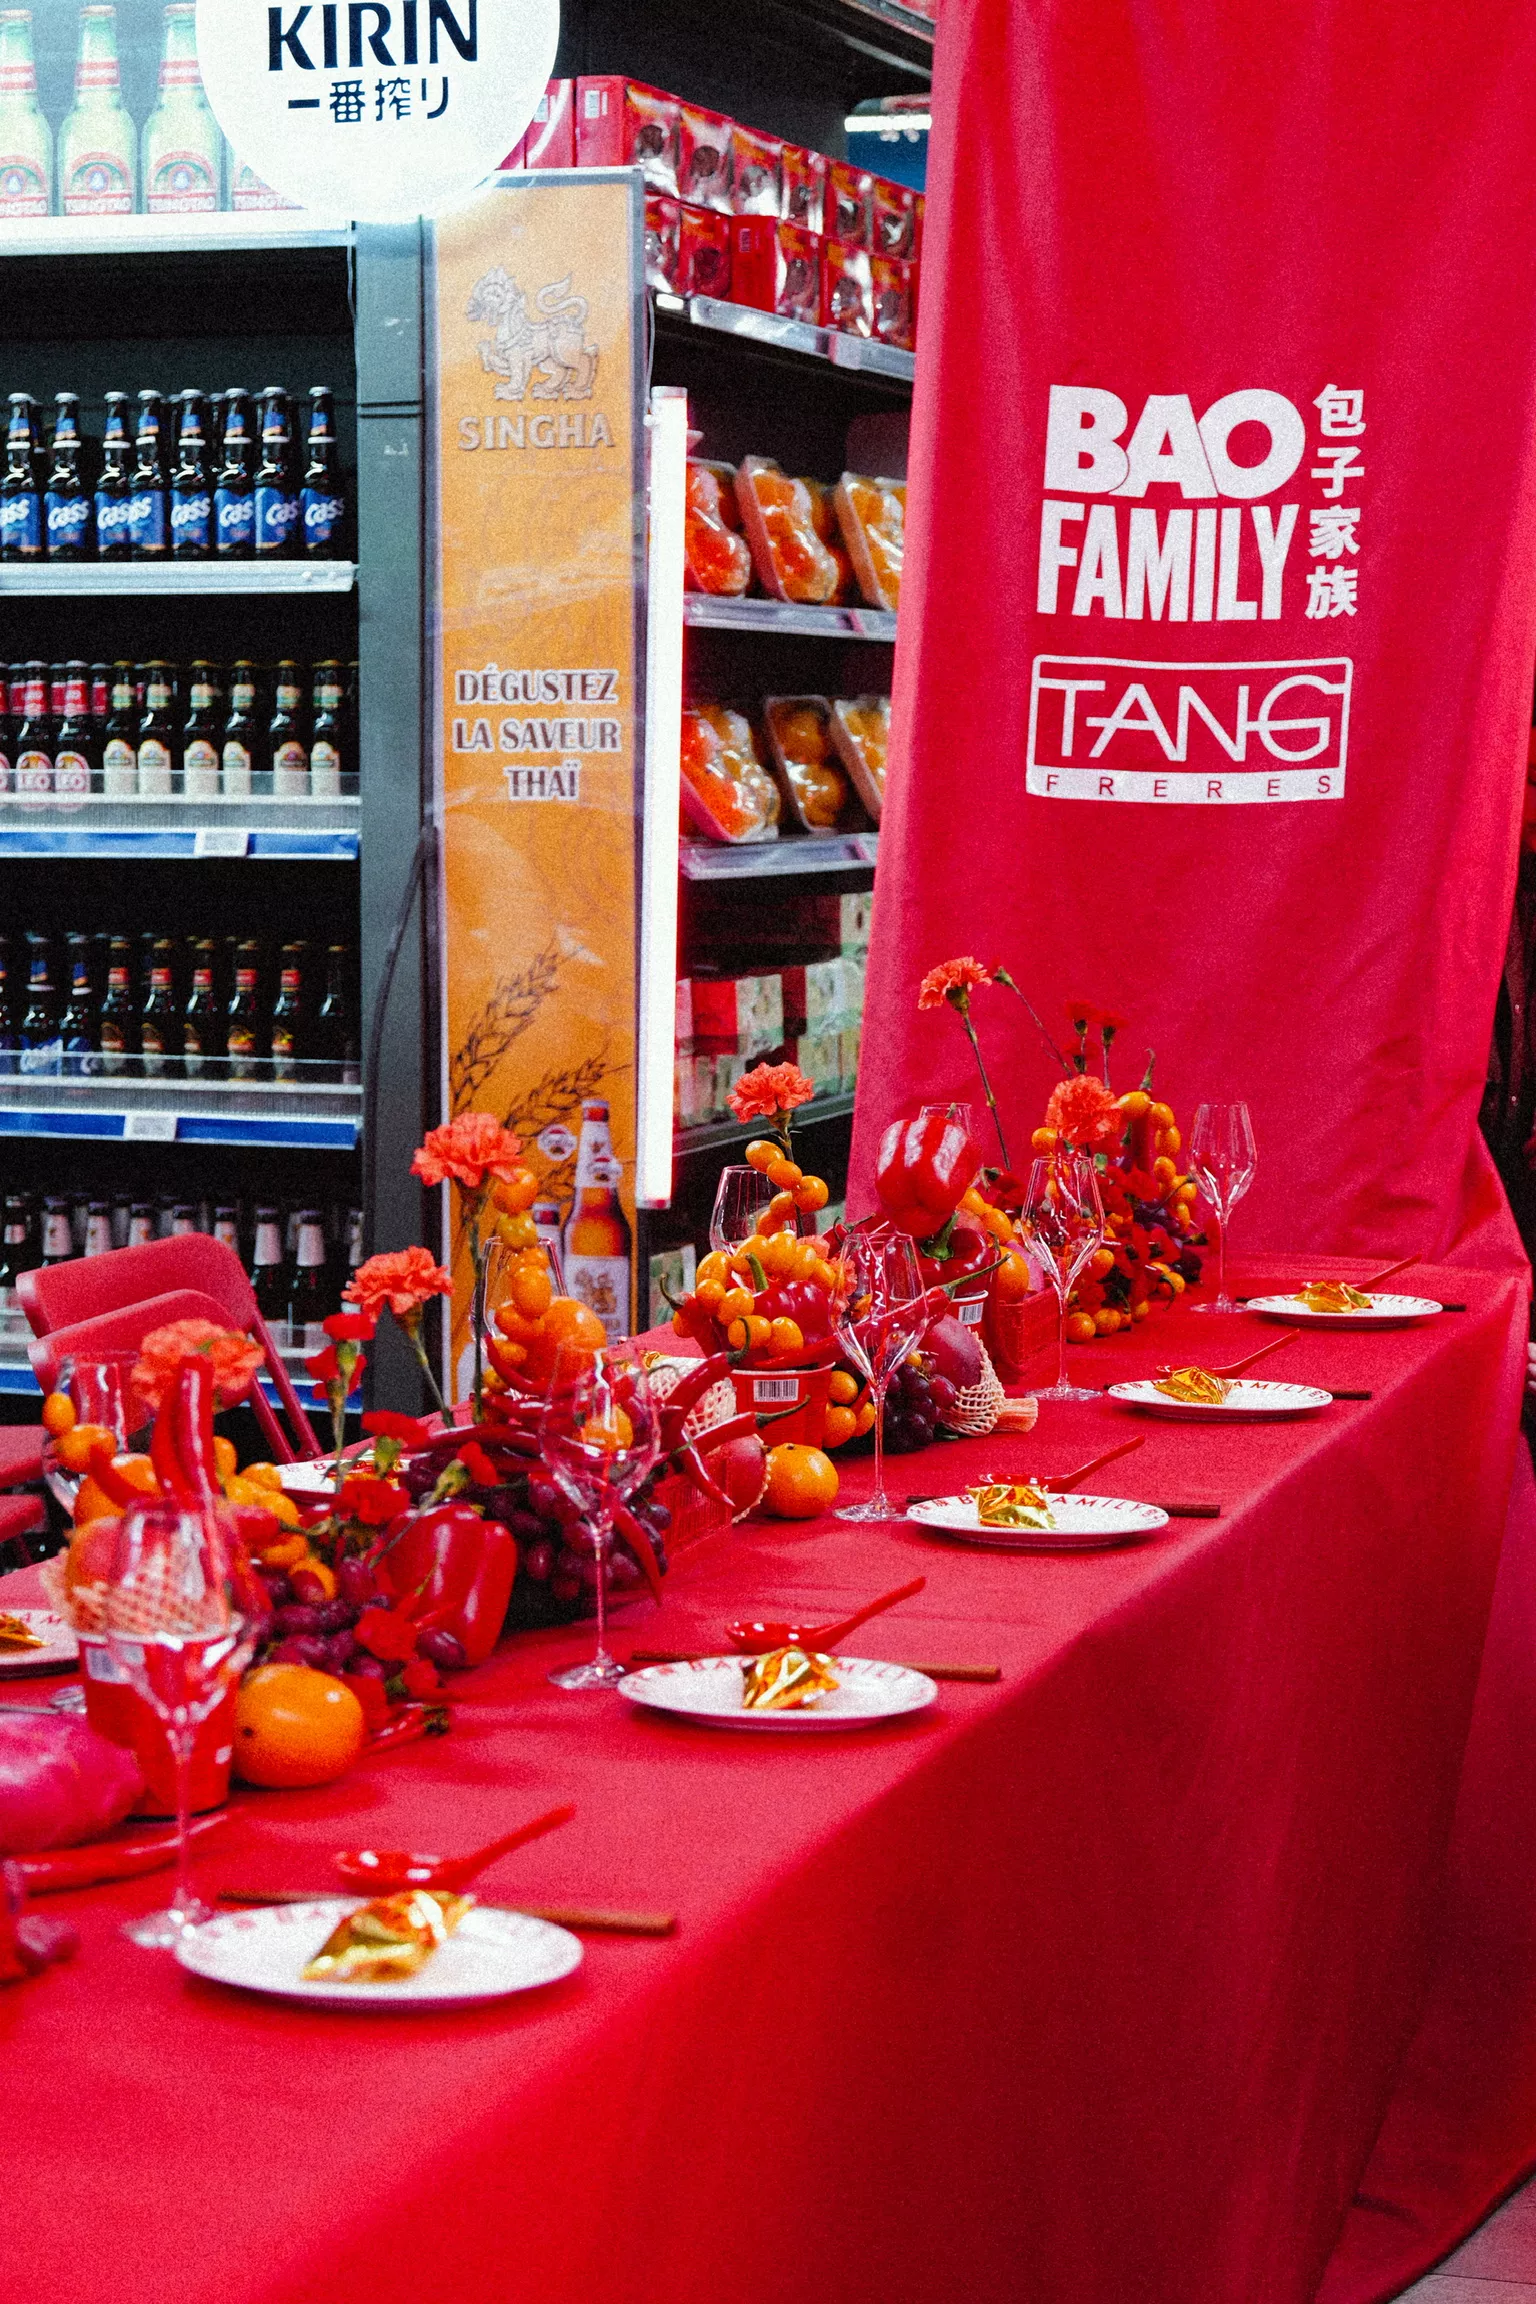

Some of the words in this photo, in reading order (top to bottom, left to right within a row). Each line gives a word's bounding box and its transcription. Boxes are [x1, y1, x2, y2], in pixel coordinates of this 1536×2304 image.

[267, 0, 480, 72] KIRIN
[287, 77, 452, 124] 一番搾り
[457, 412, 616, 452] SINGHA
[1043, 384, 1306, 499] BAO
[0, 498, 30, 528] ass
[1304, 383, 1368, 621] 包子家族
[1036, 499, 1300, 622] FAMILY
[456, 662, 618, 704] DÉGUSTEZ
[454, 717, 494, 753] LA
[500, 717, 622, 753] SAVEUR
[1037, 674, 1345, 763] TANG
[505, 761, 582, 802] THAÏ
[1045, 774, 1332, 799] FRERES
[1233, 1380, 1309, 1394] AMILY
[1051, 1495, 1146, 1512] AMILY
